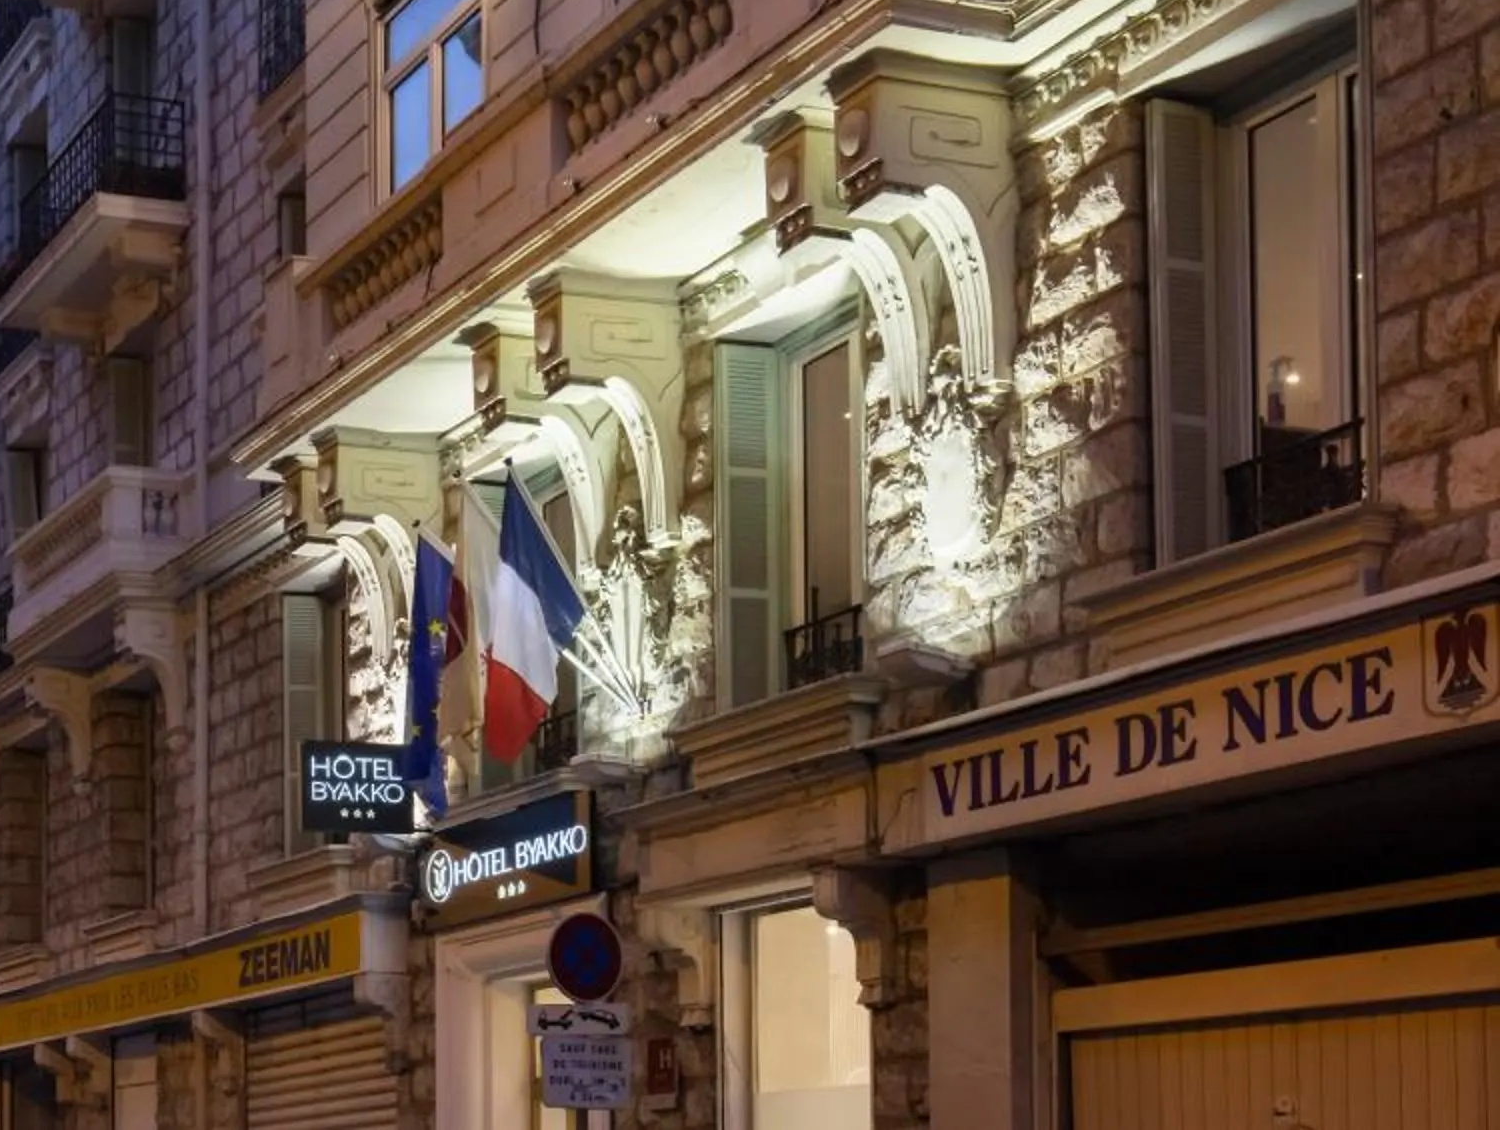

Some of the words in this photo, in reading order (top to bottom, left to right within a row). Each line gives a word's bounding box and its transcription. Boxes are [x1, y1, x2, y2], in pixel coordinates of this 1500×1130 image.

[930, 726, 1091, 818] VILLE
[1113, 699, 1196, 778] DE
[1221, 645, 1395, 753] NICE
[310, 753, 403, 782] HÔTEL
[310, 780, 405, 804] BYAKKO
[453, 847, 513, 887] HÔTEL
[515, 824, 587, 870] BYAKKO
[238, 928, 331, 988] ZEEMAN
